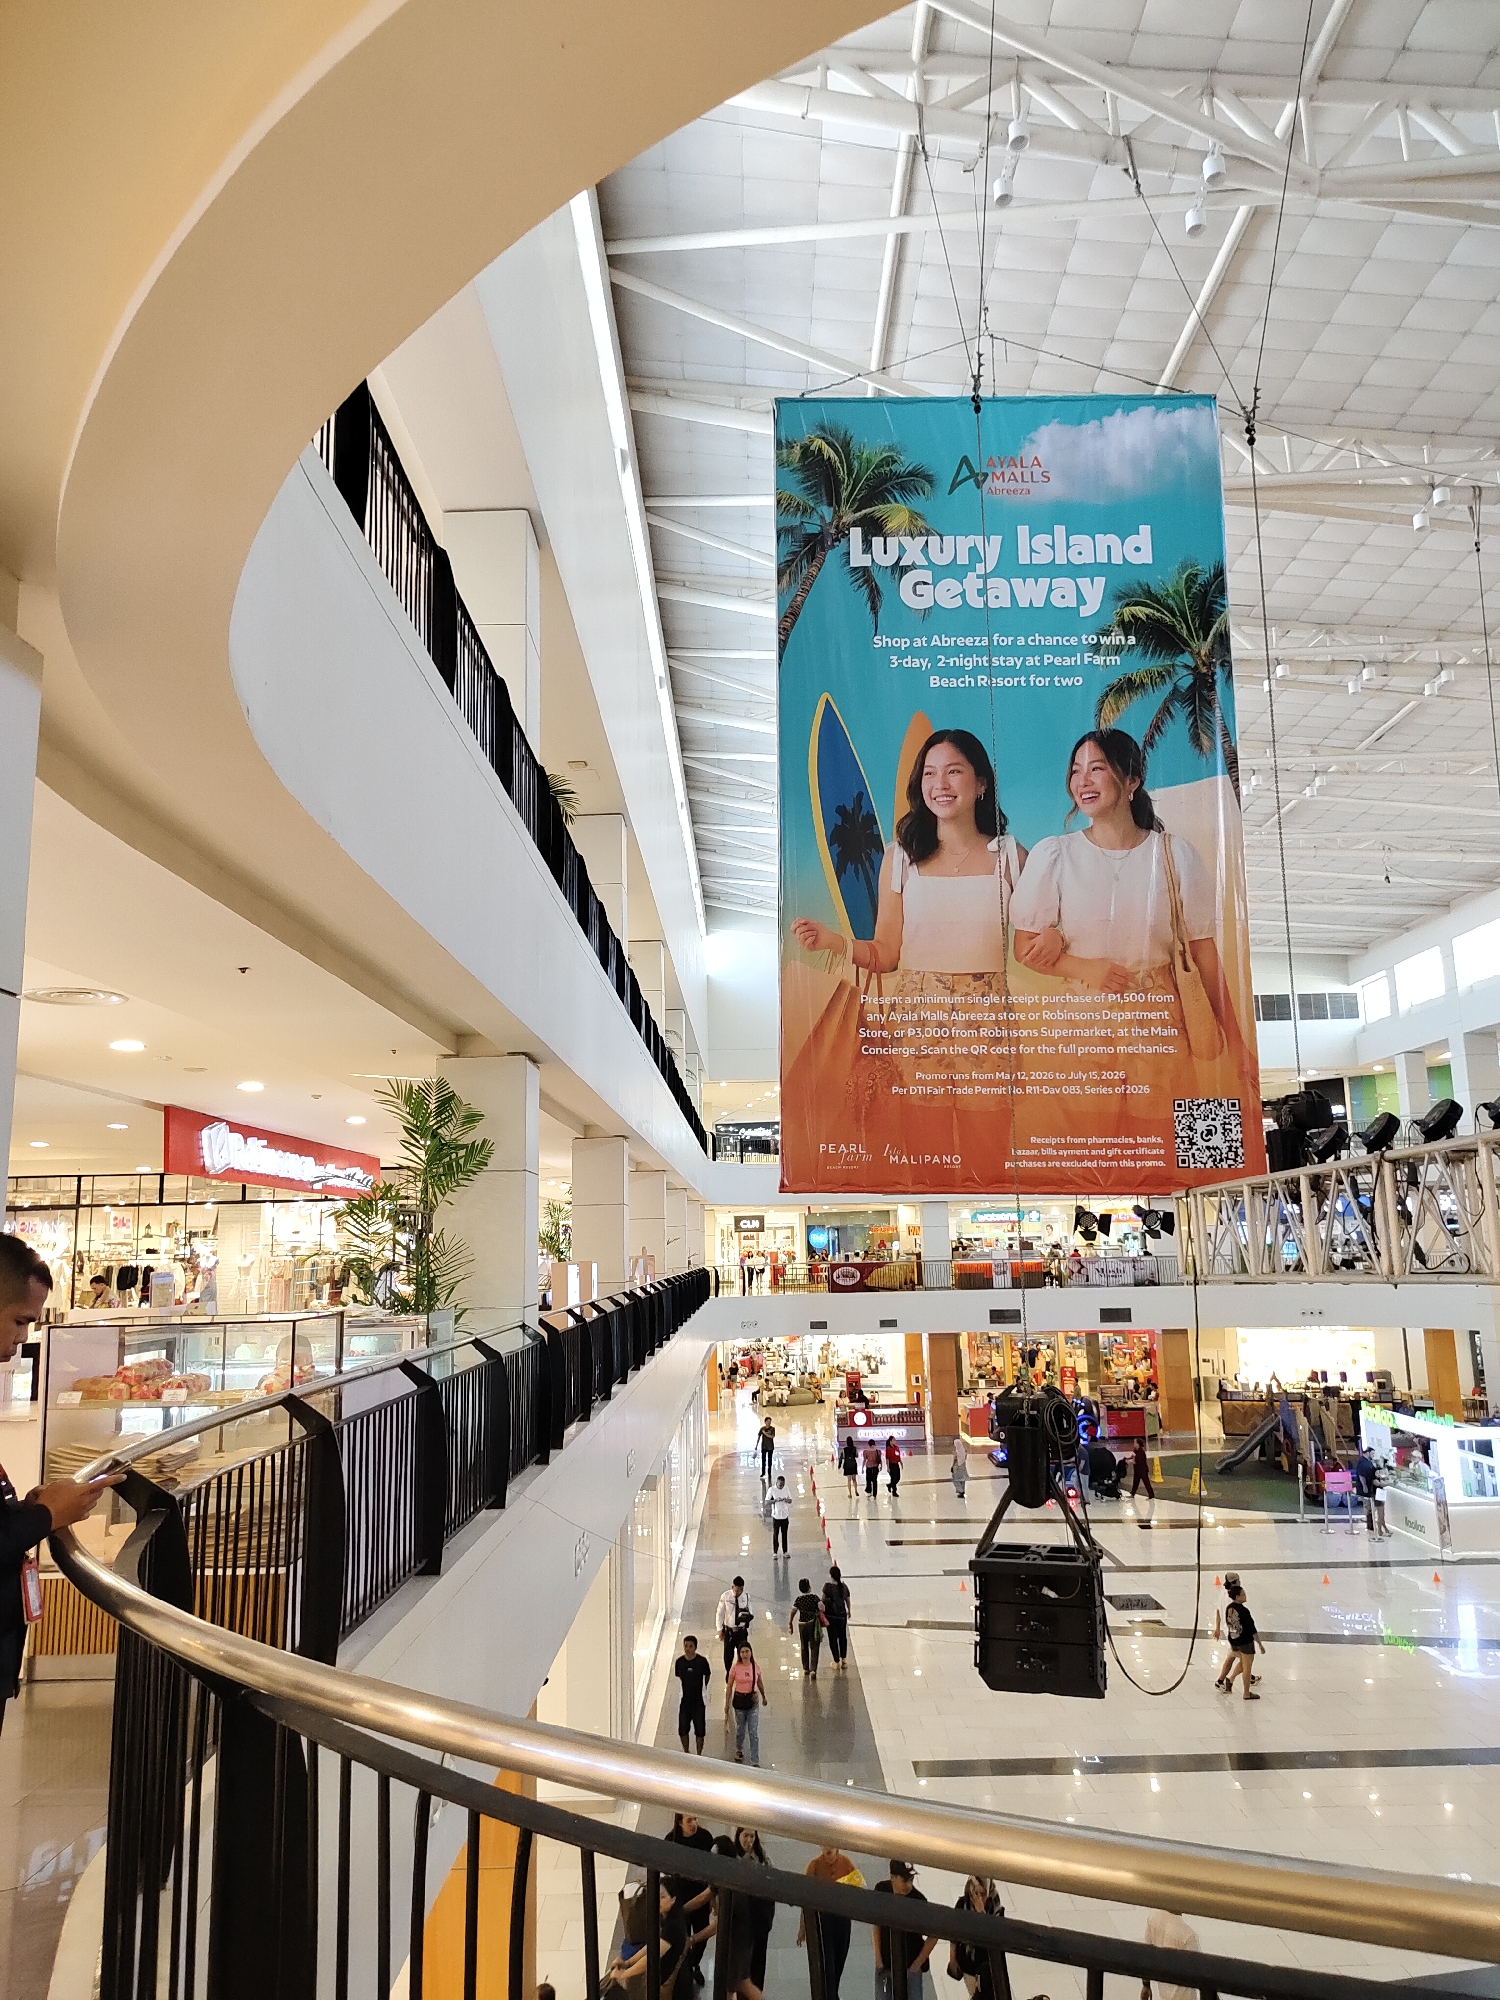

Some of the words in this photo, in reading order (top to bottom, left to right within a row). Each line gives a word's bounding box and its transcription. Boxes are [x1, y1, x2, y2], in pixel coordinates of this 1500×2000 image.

[986, 456, 1042, 468] AYALA
[992, 471, 1050, 483] MALLS
[987, 487, 1030, 495] Abreeza
[849, 526, 1002, 573] Luxury
[1017, 525, 1152, 566] Island
[900, 570, 1106, 617] Getaway
[874, 635, 910, 650] Shop
[913, 636, 927, 647] at
[931, 634, 988, 646] Abreeza
[993, 633, 1013, 646] for
[1017, 637, 1025, 645] a
[1028, 633, 1078, 645] chance
[1082, 634, 1097, 645] to
[1100, 632, 1124, 645] win
[1127, 636, 1136, 645] a
[890, 655, 931, 671] 3-day,
[937, 654, 989, 670] 2-night
[992, 656, 1023, 669] stay
[1026, 655, 1040, 666] at
[1044, 653, 1080, 666] Pearl
[1084, 652, 1121, 665] Farm
[930, 675, 974, 687] Beach
[978, 675, 1026, 686] Resort
[1029, 674, 1050, 686] for
[1054, 676, 1082, 686] two
[861, 995, 902, 1004] Present
[914, 994, 964, 1003] minimum
[968, 994, 999, 1006] single
[1002, 993, 1039, 1005] receipt
[1042, 993, 1091, 1005] purchase
[1094, 993, 1105, 1002] of
[1148, 993, 1174, 1002] from
[867, 1013, 886, 1024] any
[889, 1011, 917, 1023] Ayala
[921, 1010, 948, 1020] Malls
[951, 1011, 995, 1020] Abreeza
[998, 1012, 1025, 1020] store
[1043, 1010, 1100, 1020] Robinsons
[1102, 1010, 1169, 1022] Department
[859, 1028, 891, 1039] Store,
[952, 1027, 977, 1037] from
[980, 1027, 1038, 1037] Robinsons
[1041, 1026, 1114, 1039] Supermarket,
[1118, 1028, 1128, 1036] at
[1132, 1026, 1149, 1036] the
[1151, 1026, 1177, 1036] Main
[862, 1045, 918, 1057] Concierge.
[921, 1045, 947, 1054] Scan
[950, 1044, 968, 1054] the
[971, 1045, 987, 1055] QR
[990, 1045, 1016, 1054] code
[1019, 1044, 1035, 1053] for
[1038, 1044, 1055, 1053] the
[1059, 1044, 1075, 1053] full
[1078, 1047, 1114, 1056] promo
[1117, 1044, 1176, 1053] mechanics.
[916, 1072, 947, 1080] Promo
[972, 1071, 993, 1079] from
[996, 1072, 1015, 1081] May
[1018, 1072, 1028, 1080] 12,
[1069, 1071, 1086, 1081] July
[1089, 1072, 1099, 1080] 15,
[1102, 1071, 1125, 1079] 2026
[892, 1086, 907, 1094] Per
[910, 1086, 925, 1094] DTI
[927, 1086, 944, 1094] Fair
[947, 1086, 973, 1094] Trade
[975, 1086, 1006, 1094] Permit
[1026, 1086, 1060, 1094] R11-Dav
[1062, 1086, 1082, 1095] 083,
[1085, 1085, 1112, 1094] Series
[1115, 1085, 1125, 1093] of
[1126, 1085, 1150, 1093] 2026
[1031, 1136, 1065, 1145] Receipts
[1088, 1136, 1135, 1145] pharmacies,
[819, 1144, 866, 1153] PEARL
[883, 1144, 902, 1156] Isla
[1107, 1148, 1121, 1157] gift
[1123, 1147, 1164, 1155] certificate
[838, 1150, 872, 1164] farm
[890, 1155, 962, 1164] MALIPANO
[1005, 1160, 1046, 1169] purchases
[1120, 1159, 1135, 1167] this
[1136, 1161, 1165, 1169] promo.
